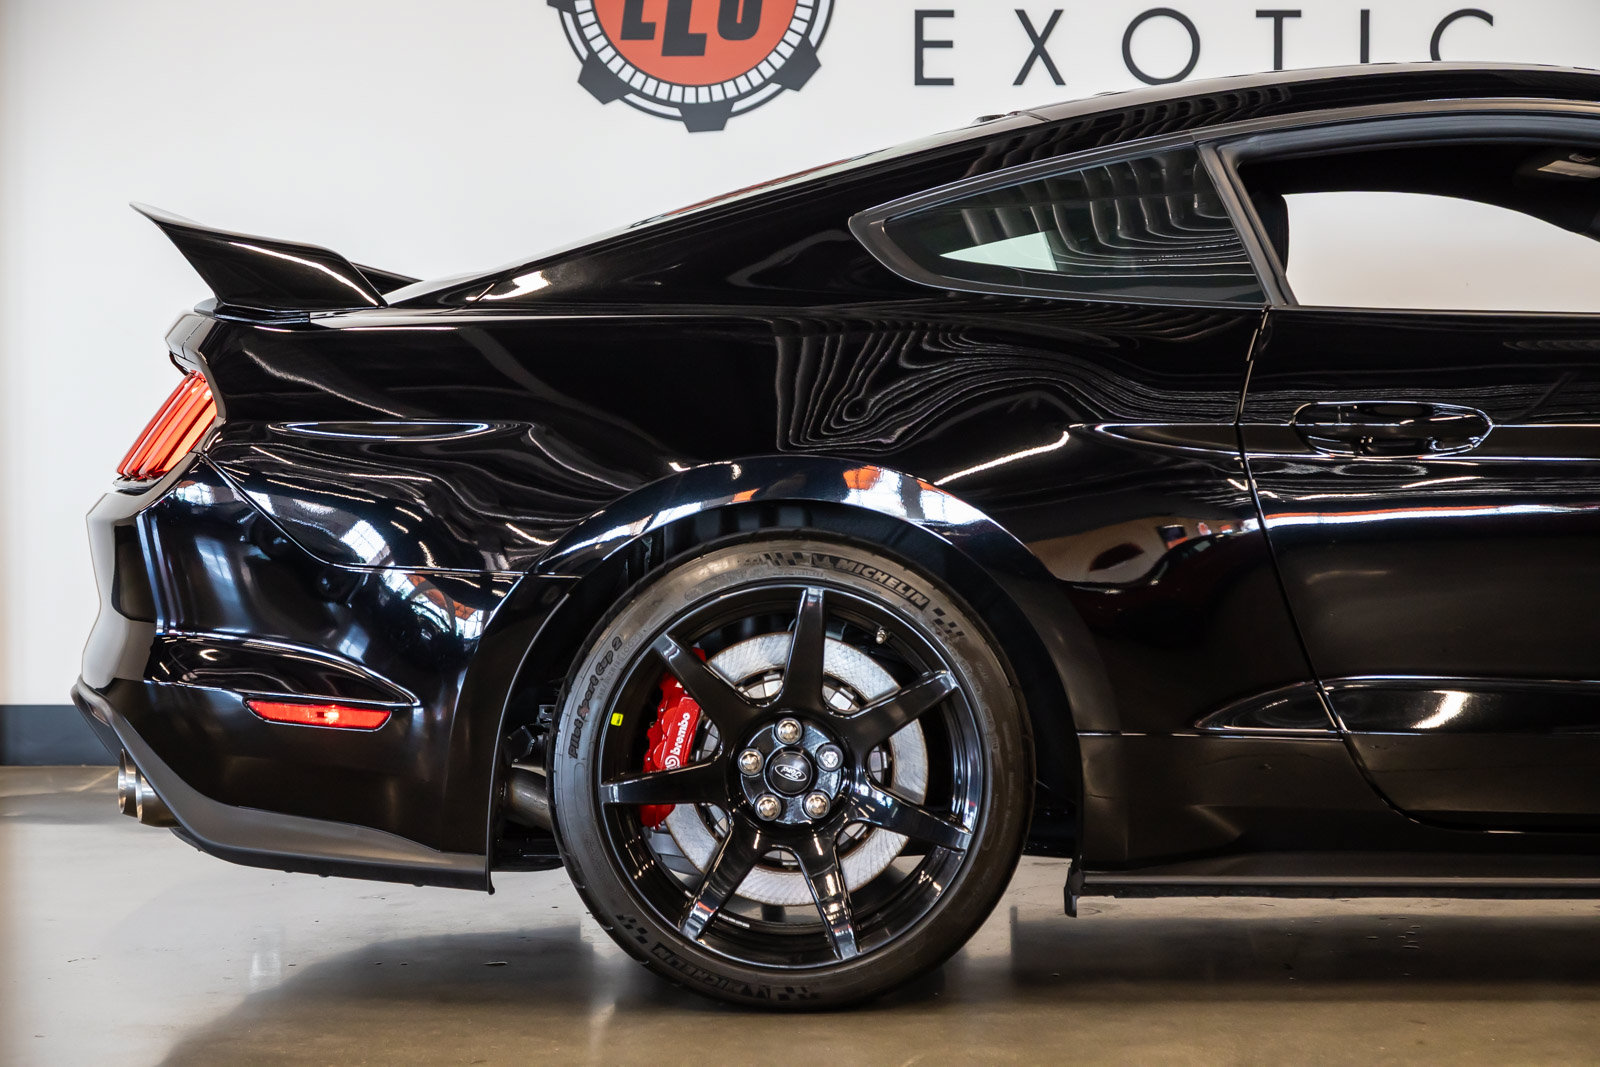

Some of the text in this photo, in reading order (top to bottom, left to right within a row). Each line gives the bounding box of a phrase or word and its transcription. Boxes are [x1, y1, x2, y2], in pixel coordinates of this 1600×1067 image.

[915, 8, 1494, 86] EXOTIC
[836, 560, 929, 606] MICHELIN
[612, 636, 622, 651] 2
[670, 712, 691, 756] brembo
